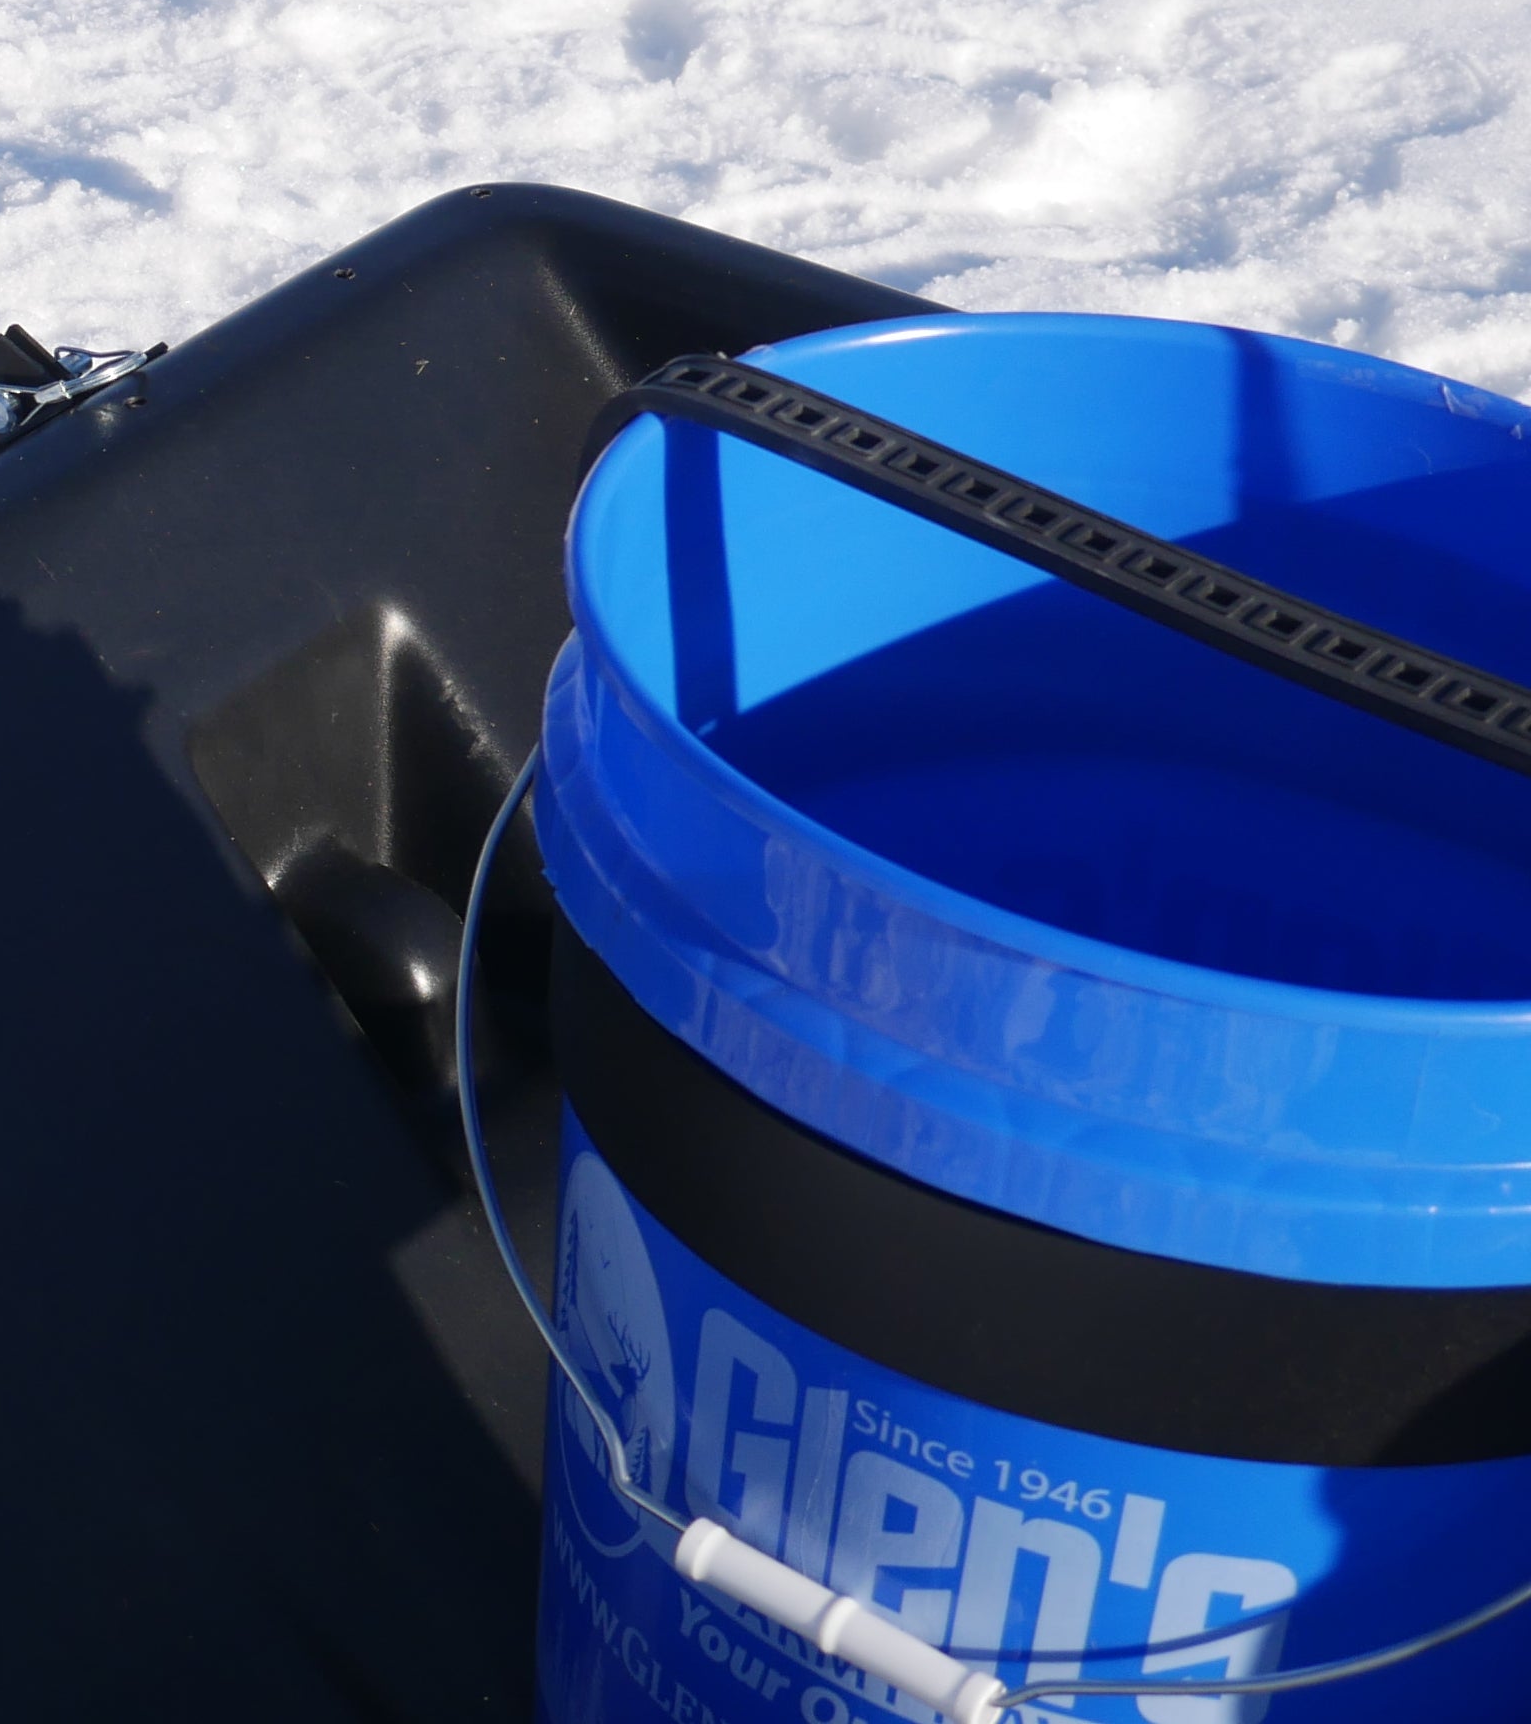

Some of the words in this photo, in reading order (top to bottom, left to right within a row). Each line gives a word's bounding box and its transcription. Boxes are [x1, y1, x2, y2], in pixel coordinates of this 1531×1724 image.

[685, 1307, 1298, 1724] Glen's
[851, 1399, 975, 1479] Since
[993, 1459, 1112, 1520] 1946
[679, 1586, 791, 1701] Your
